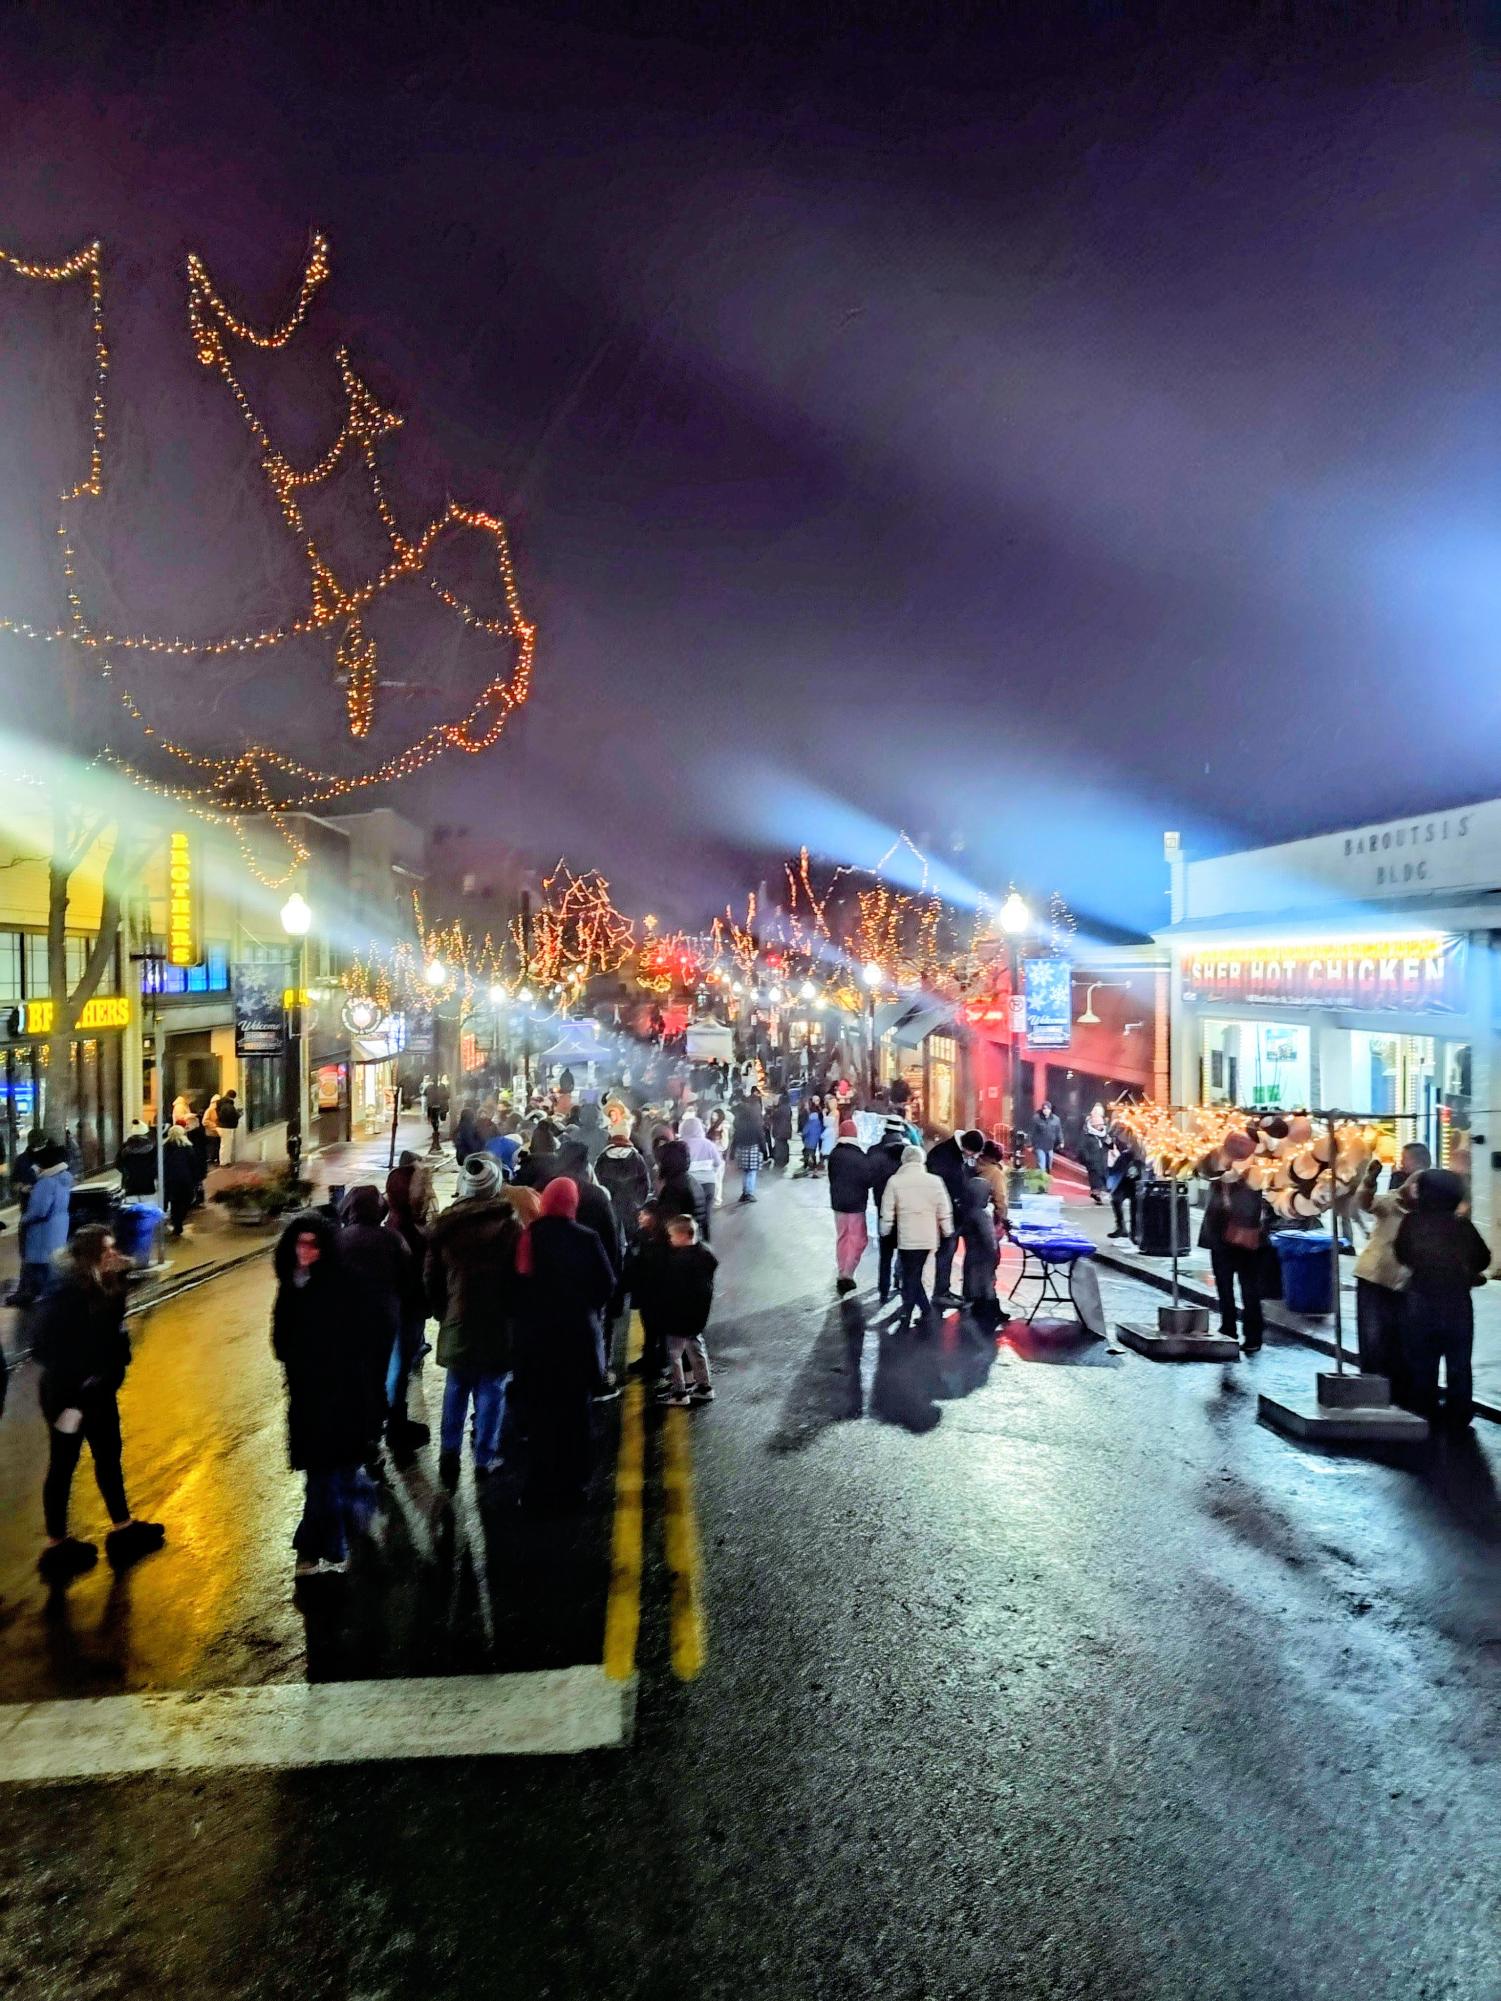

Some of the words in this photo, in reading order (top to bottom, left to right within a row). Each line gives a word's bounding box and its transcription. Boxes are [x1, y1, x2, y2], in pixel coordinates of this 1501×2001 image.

[1344, 816, 1470, 856] BAROUTSIS
[1376, 860, 1428, 885] BLDG
[170, 833, 191, 963] BROTHERS
[1250, 959, 1297, 988] HOT
[1307, 956, 1446, 989] CHICKEN
[27, 998, 130, 1034] BRHERS
